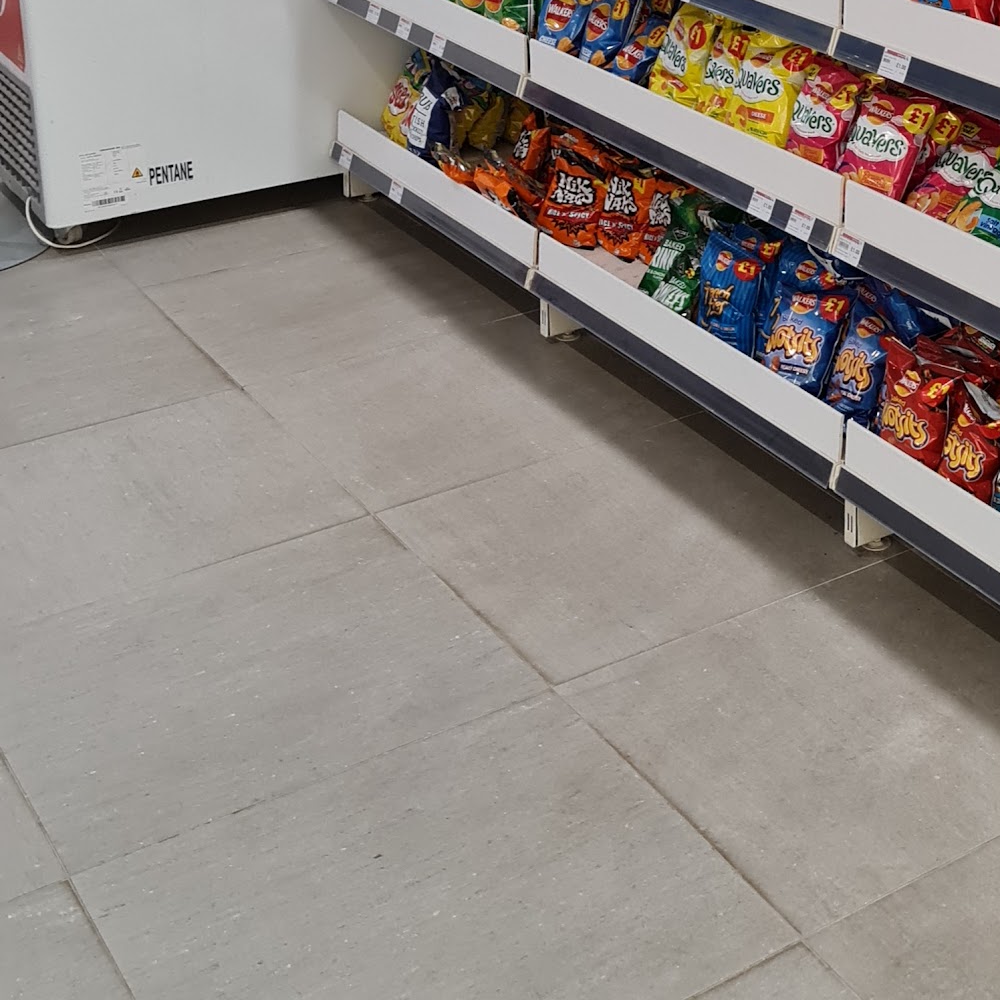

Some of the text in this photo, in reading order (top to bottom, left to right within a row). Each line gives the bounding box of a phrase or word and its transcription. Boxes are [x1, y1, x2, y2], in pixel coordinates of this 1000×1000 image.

[548, 3, 575, 19] WALKERS
[613, 0, 625, 16] £1
[650, 28, 665, 44] £1
[690, 25, 704, 46] £1
[731, 36, 749, 55] £1
[909, 108, 929, 129] £1
[935, 118, 954, 135] £1
[148, 161, 194, 186] PENTANE
[663, 239, 686, 251] BAKED
[825, 297, 845, 315] £1
